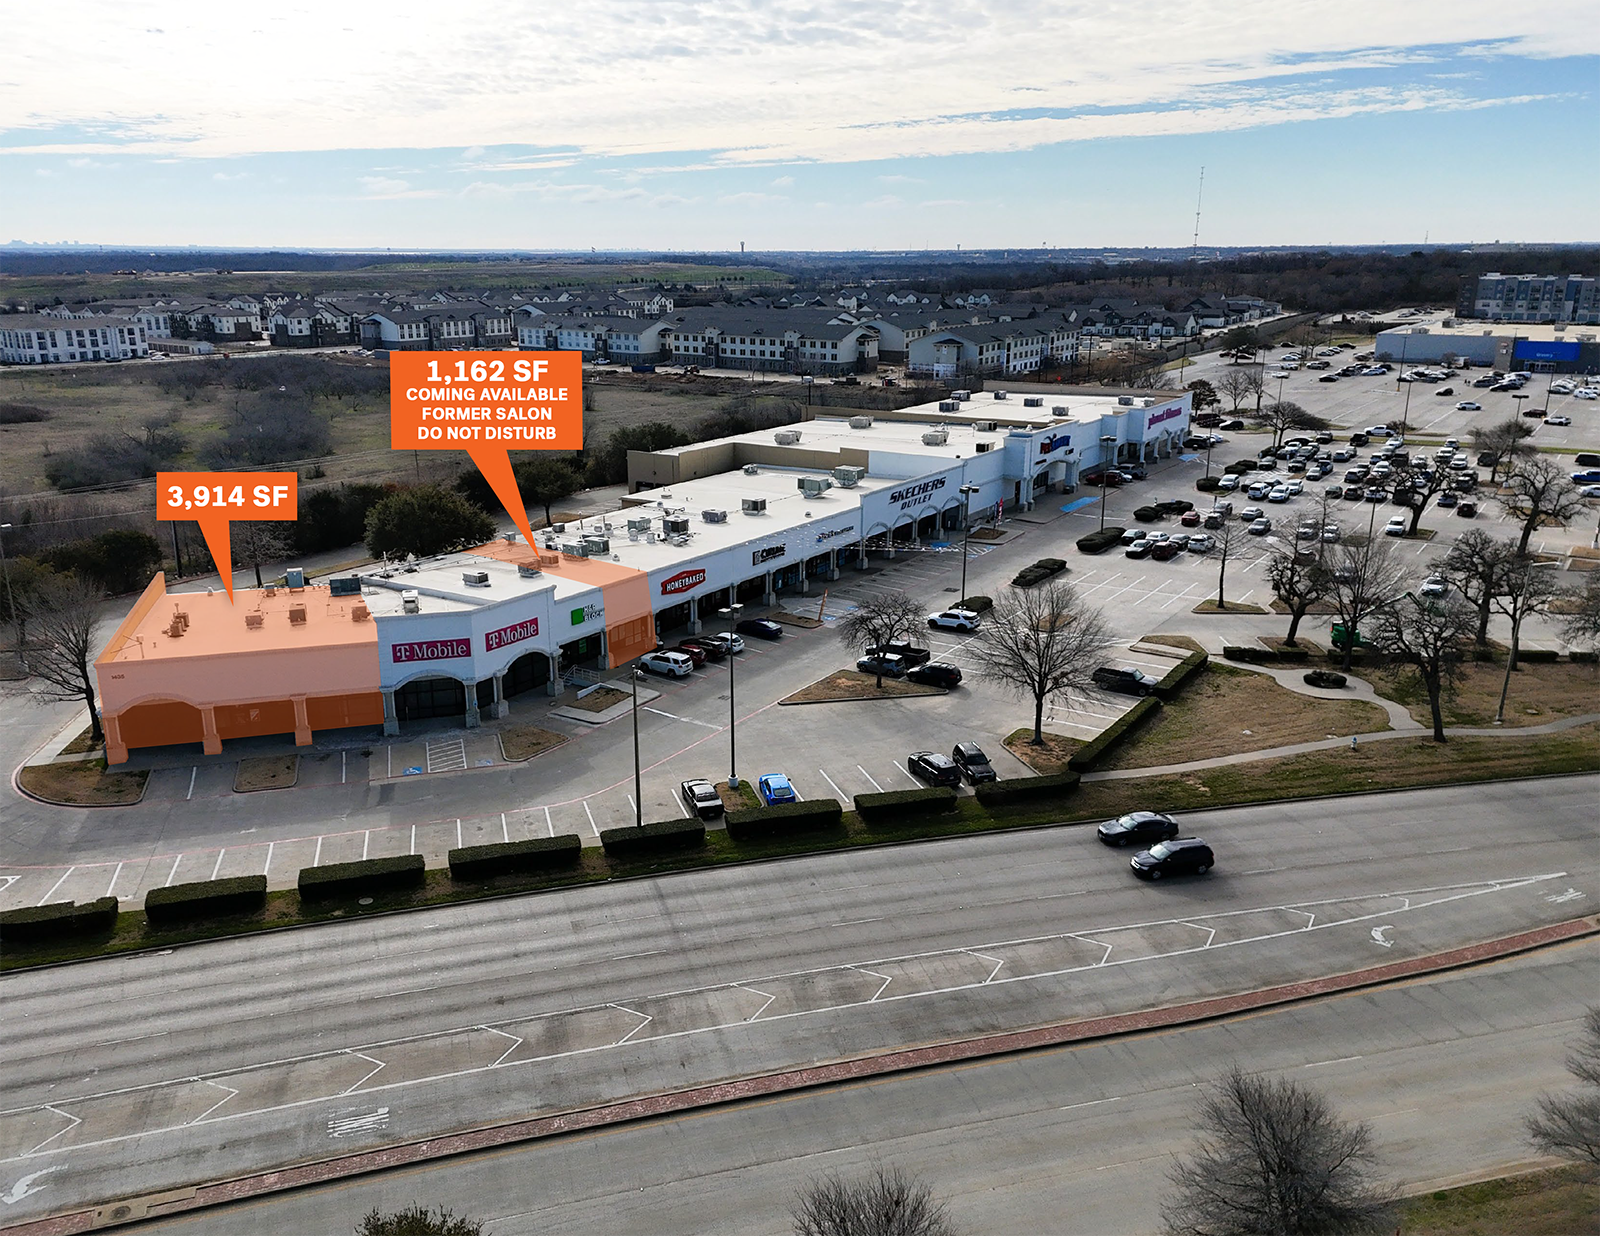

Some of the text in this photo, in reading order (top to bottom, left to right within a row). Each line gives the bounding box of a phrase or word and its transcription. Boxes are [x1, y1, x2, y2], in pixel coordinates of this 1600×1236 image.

[888, 476, 947, 505] SKECHERS
[900, 493, 933, 510] OUTLET
[666, 573, 704, 592] HONEYBAKED
